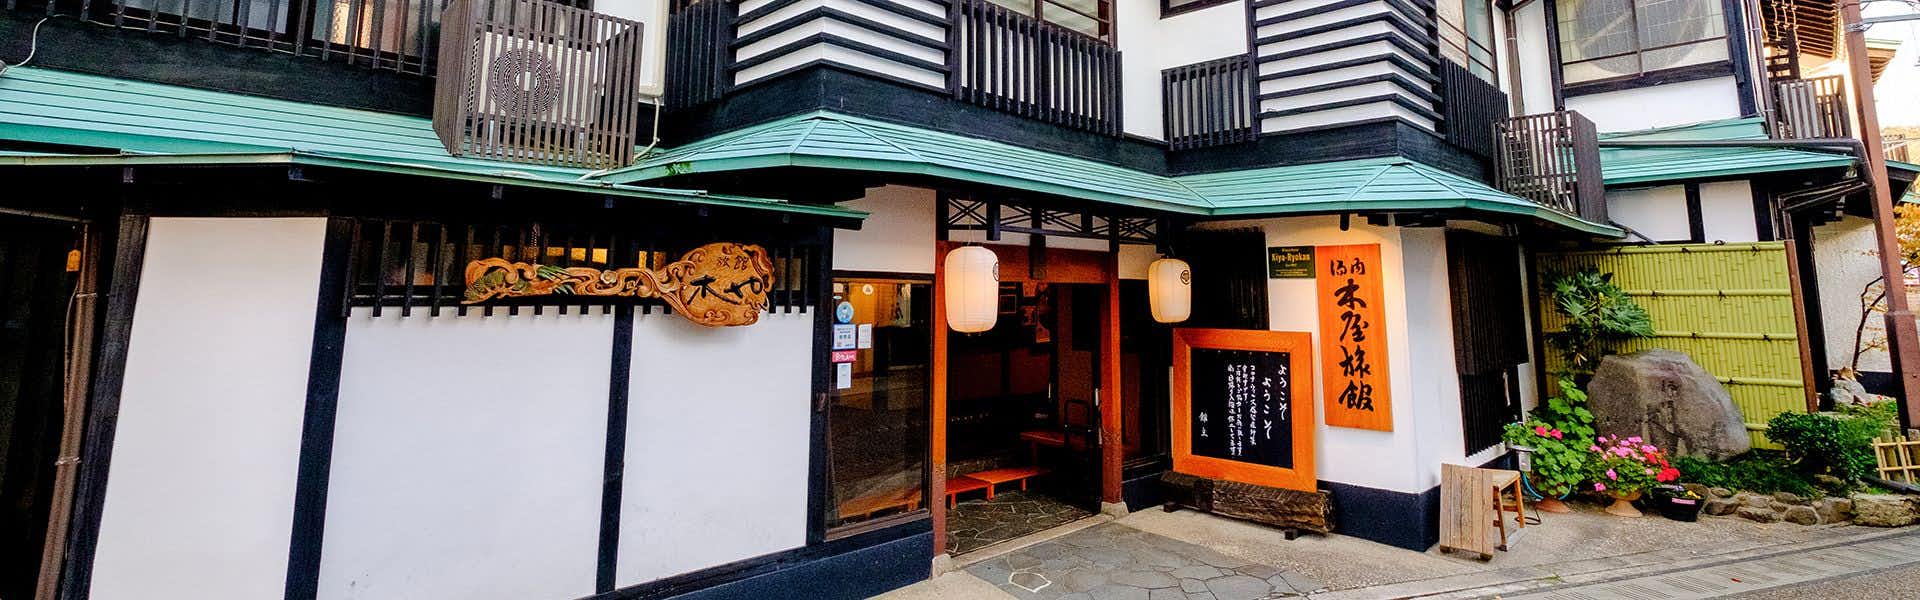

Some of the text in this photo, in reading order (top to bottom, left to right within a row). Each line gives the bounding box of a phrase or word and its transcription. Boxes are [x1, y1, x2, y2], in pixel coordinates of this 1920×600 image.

[687, 274, 764, 306] 木や
[1334, 278, 1374, 412] 木屋旅館
[1262, 376, 1273, 440] ようこそ
[1278, 364, 1288, 421] ようこそ
